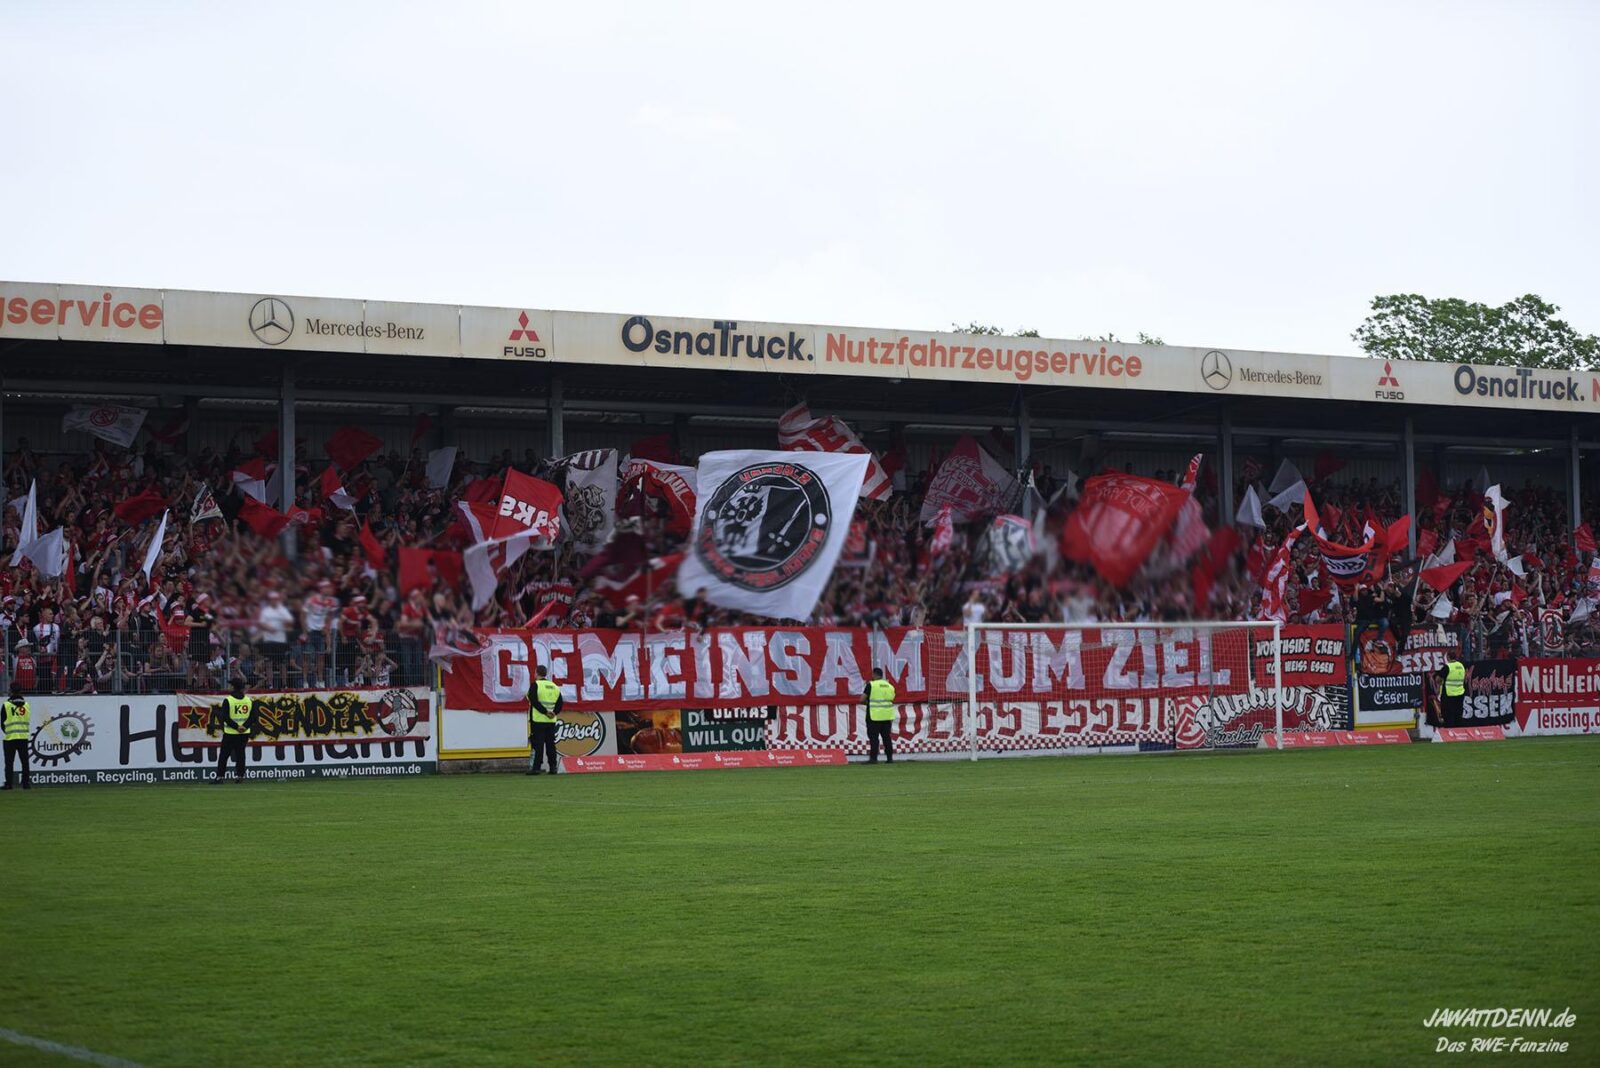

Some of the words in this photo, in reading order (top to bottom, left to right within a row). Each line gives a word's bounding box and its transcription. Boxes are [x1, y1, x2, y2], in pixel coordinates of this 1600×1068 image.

[0, 292, 163, 330] service
[305, 318, 425, 340] Mercedes-Benz
[621, 315, 815, 362] OsnaTruck.
[503, 346, 546, 358] FUSO
[825, 332, 1143, 382] Nutzfahrzeugservice
[1239, 367, 1323, 386] Mercedes-Benz
[1454, 365, 1585, 402] OsnaTruck.
[1375, 390, 1404, 400] FUSO
[1315, 639, 1343, 656] CREW
[482, 629, 926, 702] GEMEINSAM
[944, 629, 1085, 694] ZUM
[1101, 627, 1231, 690] ZIEL
[1284, 661, 1308, 673] WEISS
[1310, 660, 1334, 674] ESSEN
[1401, 651, 1448, 673] ESSE
[1359, 673, 1422, 689] Commando
[1373, 690, 1409, 705] Essen
[1462, 692, 1513, 719] SSEN
[11, 705, 26, 716] K9
[234, 704, 249, 715] K9
[1038, 698, 1170, 735] ESSEN
[688, 728, 729, 746] WILL
[97, 770, 157, 784] Recycling,
[162, 769, 198, 781] Landt.
[203, 767, 305, 780] Lonuternehmen
[321, 765, 422, 777] www.huntmann.de
